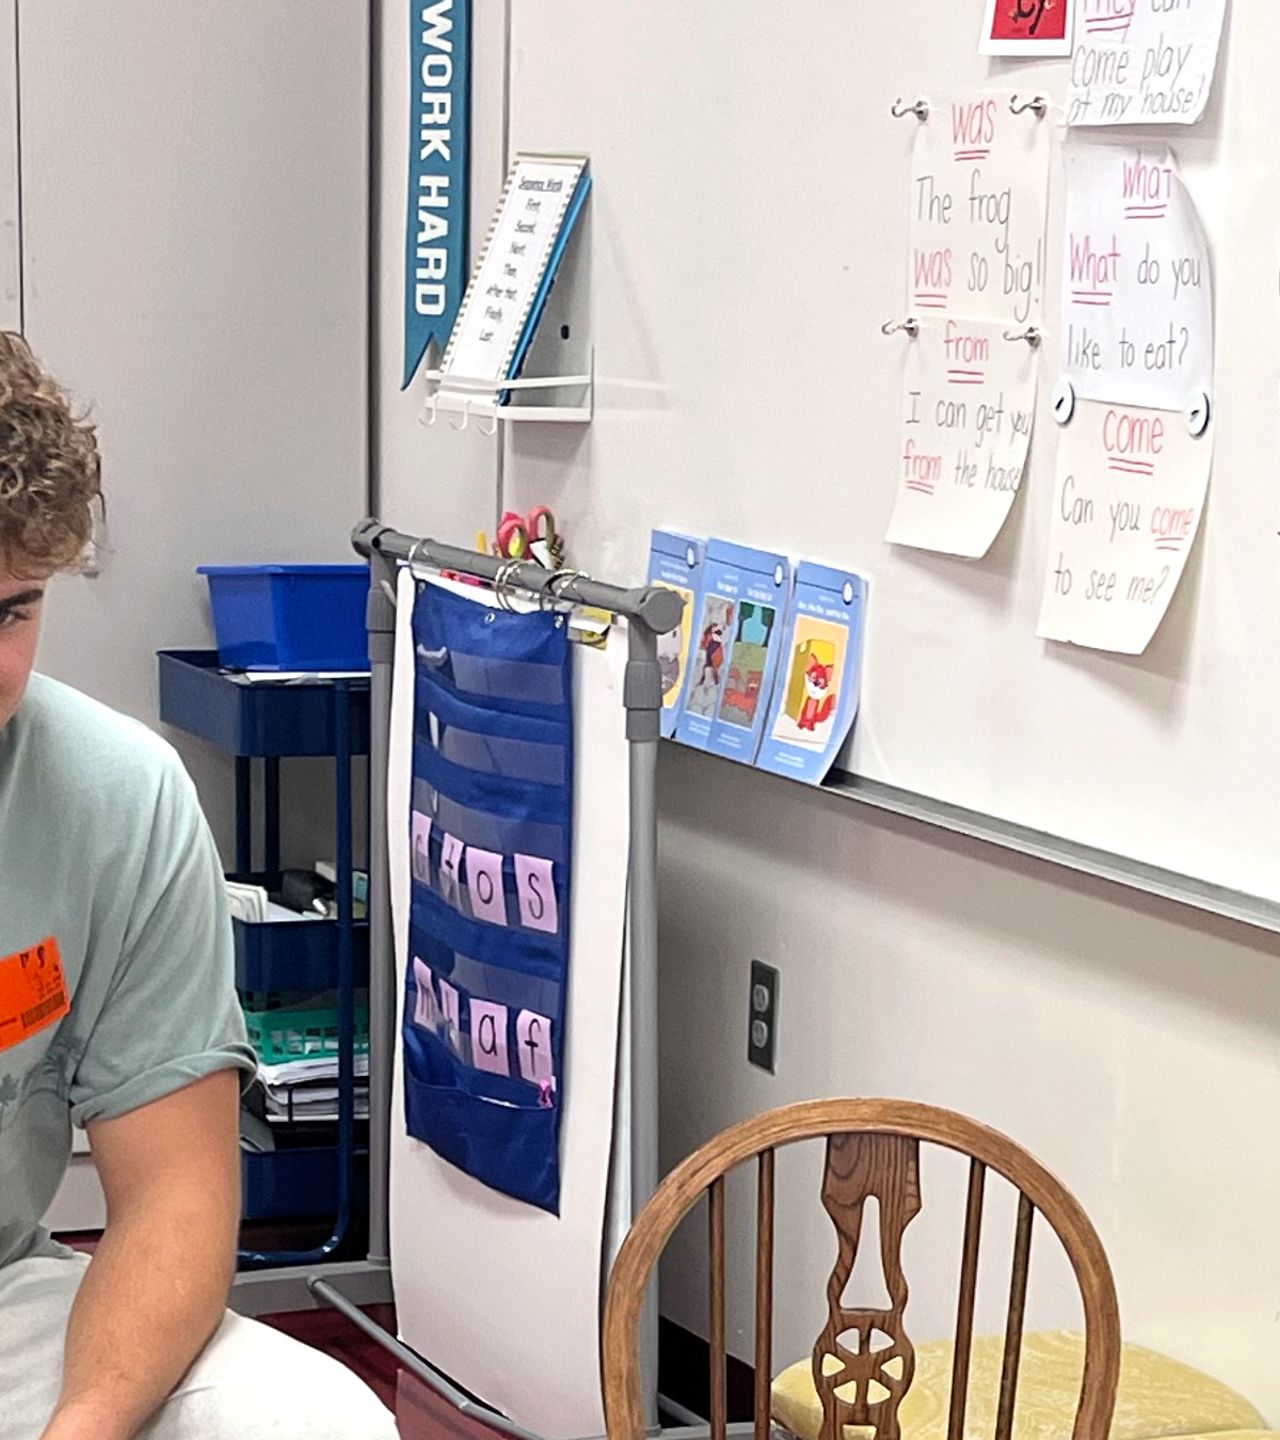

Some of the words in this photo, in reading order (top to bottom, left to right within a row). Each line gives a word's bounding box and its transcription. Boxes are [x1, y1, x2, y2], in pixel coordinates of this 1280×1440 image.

[421, 0, 454, 162] WORK
[1072, 45, 1129, 88] come
[1140, 31, 1194, 91] play
[951, 99, 995, 145] was
[1100, 92, 1132, 122] my
[1141, 74, 1207, 115] house!
[916, 175, 953, 225] The
[969, 170, 1012, 254] frog
[414, 175, 450, 316] HARD
[1137, 244, 1160, 285] do
[1172, 251, 1202, 301] you
[914, 246, 952, 290] was
[967, 252, 989, 291] so
[1003, 231, 1042, 323] big!
[943, 330, 990, 364] from
[1066, 322, 1102, 371] like
[1120, 326, 1136, 368] to
[1143, 325, 1188, 370] eat?
[907, 391, 922, 425] I
[935, 398, 967, 430] can
[975, 391, 1005, 448] get
[1102, 409, 1165, 455] come
[903, 438, 942, 482] from
[953, 449, 979, 487] the
[1060, 475, 1094, 524] Can
[1108, 502, 1141, 548] you
[1150, 504, 1194, 536] come
[1053, 551, 1072, 596] to
[1088, 566, 1116, 603] see
[1126, 554, 1166, 603] me?
